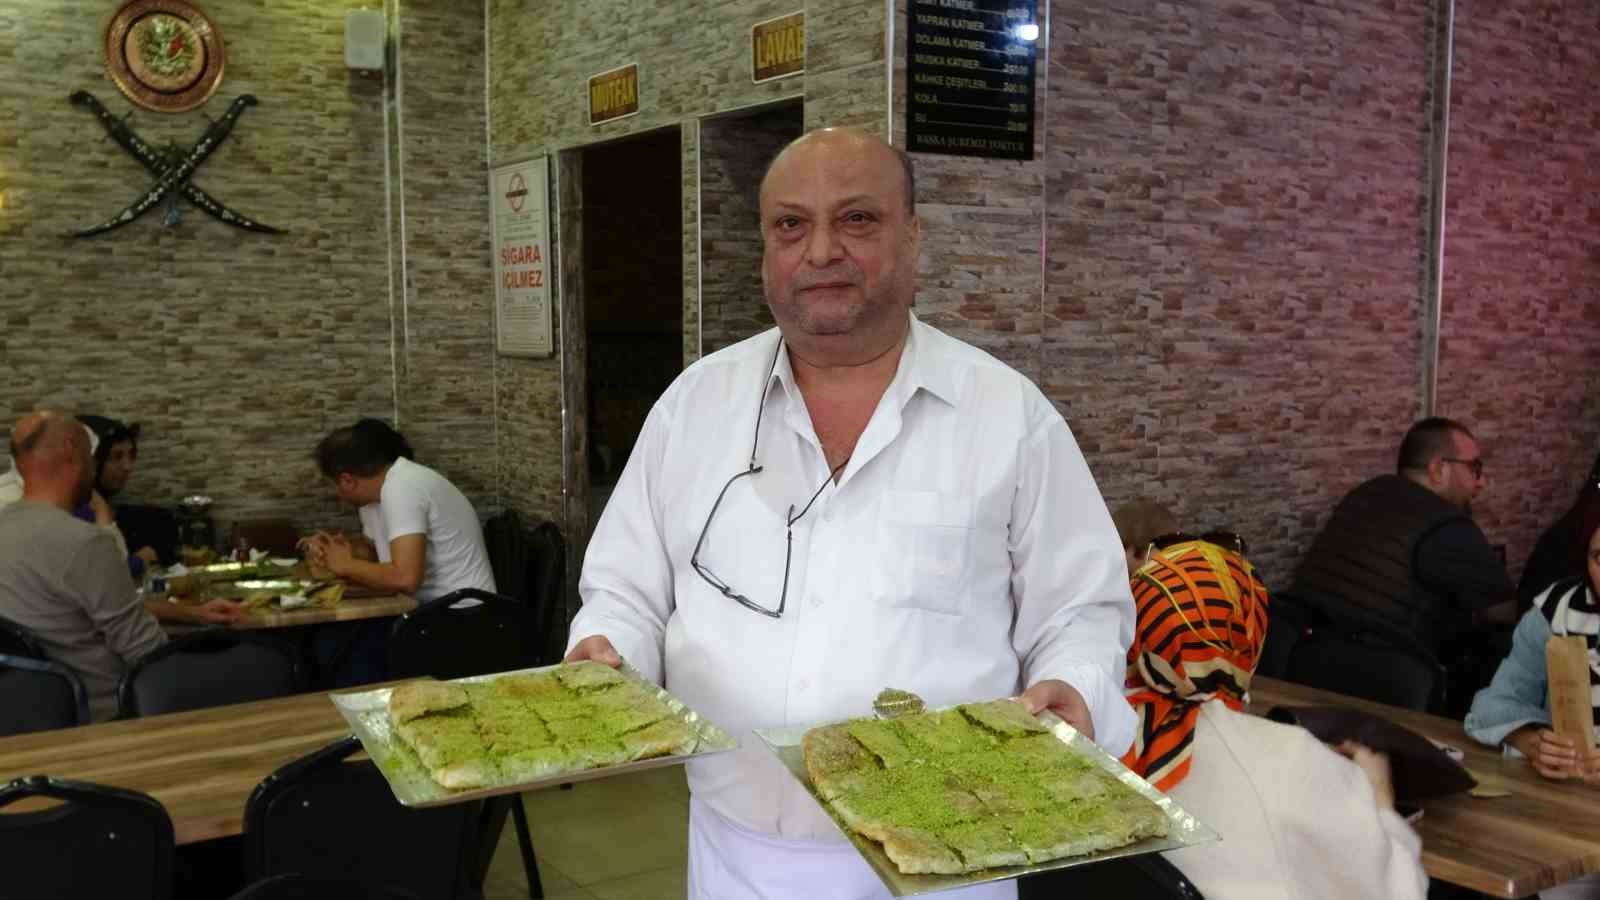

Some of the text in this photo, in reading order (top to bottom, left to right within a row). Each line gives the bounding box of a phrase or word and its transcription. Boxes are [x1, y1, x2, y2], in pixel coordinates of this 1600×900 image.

[915, 14, 984, 31] YAPRAK KATMER
[914, 33, 985, 50] DOLAMA KATMER
[947, 57, 979, 70] KATMER
[591, 73, 635, 113] MUTFAK
[914, 92, 939, 103] KOLA
